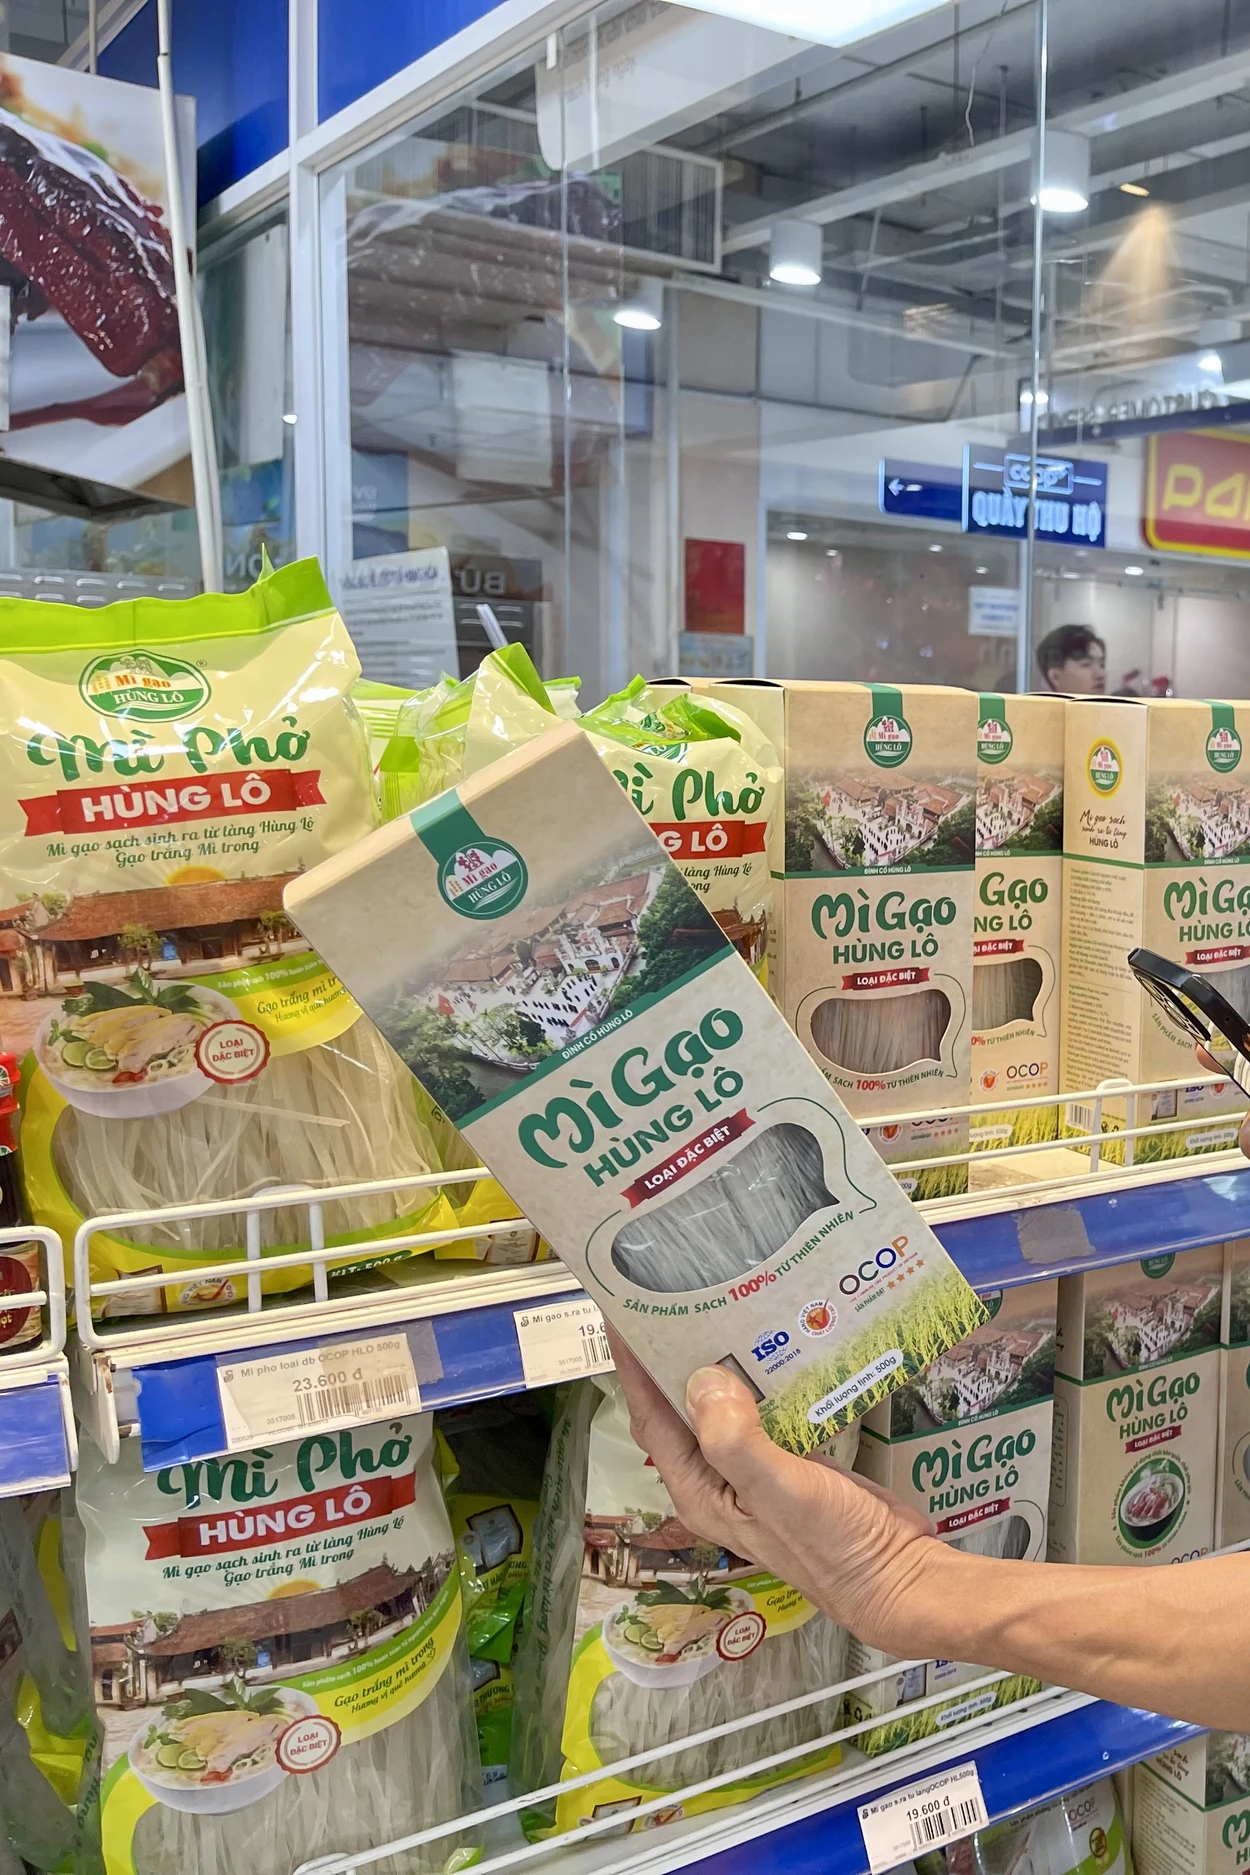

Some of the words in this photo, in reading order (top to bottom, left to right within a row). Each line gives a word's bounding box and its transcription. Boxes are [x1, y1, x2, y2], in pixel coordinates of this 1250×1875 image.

[1030, 499, 1069, 533] THU
[1072, 501, 1101, 542] HỘ
[113, 689, 159, 705] HÙNG
[161, 691, 184, 703] LÔ
[182, 716, 312, 774] Phở
[81, 785, 211, 823] HÙNG
[221, 773, 271, 807] LÔ
[46, 843, 67, 857] Mì
[72, 842, 100, 857] gạo
[105, 837, 140, 852] sạch
[145, 831, 176, 846] sinh
[182, 831, 199, 842] ra
[204, 827, 219, 840] từ
[223, 825, 256, 840] làng
[259, 820, 296, 836] Hùng
[300, 816, 315, 832] Lô
[115, 851, 147, 868] Gạo
[151, 844, 192, 861] trắng
[198, 844, 217, 856] Mì
[222, 840, 260, 854] trong
[691, 823, 728, 852] LÔ
[468, 881, 497, 903] HÙNG
[495, 870, 511, 886] LÔ
[684, 867, 711, 881] làng
[713, 865, 740, 877] Hùng
[742, 862, 753, 875] Lô
[979, 872, 1048, 910] Gạo
[875, 890, 957, 934] Gạo
[832, 938, 905, 965] HÙNG
[910, 932, 939, 958] LÔ
[1179, 920, 1233, 943] HÙNG
[220, 1039, 243, 1049] LOẠI
[562, 1041, 584, 1060] ĐÌNH
[583, 1030, 597, 1044] CỔ
[597, 1018, 622, 1036] HÙNG
[621, 1009, 633, 1021] LÔ
[212, 1051, 232, 1062] ĐẶC
[234, 1049, 255, 1059] BIỆT
[611, 1008, 744, 1107] Gạo
[1006, 1061, 1049, 1080] OCOP
[583, 1105, 693, 1187] HÙNG
[694, 1066, 744, 1113] LÔ
[644, 1163, 677, 1190] LOẠI
[676, 1144, 704, 1171] ĐẶC
[703, 1126, 730, 1150] BIỆT
[622, 1298, 649, 1315] SẢN
[651, 1302, 689, 1316] PHẨM
[694, 1296, 728, 1314] SẠCH
[728, 1270, 777, 1302] 100%
[774, 1259, 791, 1277] TỪ
[789, 1234, 821, 1265] THIÊN
[818, 1210, 854, 1238] NHIÊN
[838, 1235, 909, 1295] OCOP
[532, 1315, 543, 1323] Mi
[545, 1313, 562, 1323] gao
[564, 1309, 580, 1317] s.ra
[854, 1302, 864, 1313] SẢN
[863, 1294, 877, 1308] PHẨM
[875, 1287, 885, 1299] ĐẠT
[579, 1321, 606, 1337] 19.6
[751, 1331, 789, 1362] ISO
[240, 1367, 254, 1377] Mi
[257, 1363, 277, 1376] pho
[280, 1359, 299, 1370] loai
[302, 1357, 315, 1368] db
[318, 1350, 349, 1363] OCOP
[352, 1345, 374, 1357] HLO
[377, 1340, 401, 1352] 500g
[764, 1348, 802, 1375] 22000:2018
[293, 1370, 347, 1392] 23.600
[352, 1367, 363, 1381] đ
[814, 1399, 835, 1418] Khối
[834, 1384, 859, 1404] lượng
[857, 1370, 876, 1387] tịnh:
[875, 1355, 897, 1374] 500g
[1147, 1372, 1200, 1407] Gạo
[1119, 1413, 1166, 1440] HÙNG
[1169, 1402, 1188, 1424] LÔ
[297, 1422, 412, 1492] Phở
[966, 1429, 1036, 1473] Gạo
[929, 1479, 990, 1513] HÙNG
[995, 1465, 1019, 1492] LÔ
[200, 1505, 316, 1546] HÙNG
[325, 1485, 372, 1521] LÔ
[163, 1567, 181, 1579] Mì
[185, 1563, 211, 1578] gạo
[215, 1556, 248, 1573] sạch
[252, 1550, 281, 1565] sinh
[286, 1547, 301, 1558] ra
[306, 1541, 321, 1554] từ
[323, 1534, 353, 1551] làng
[357, 1523, 389, 1541] Hùng
[393, 1515, 405, 1529] Lô
[224, 1571, 253, 1587] Gạo
[256, 1562, 294, 1579] trắng
[300, 1557, 317, 1570] Mì
[321, 1549, 354, 1565] trong
[734, 1626, 751, 1636] LOẠI
[334, 1693, 359, 1708] Gạo
[362, 1675, 393, 1696] trắng
[396, 1661, 410, 1679] mì
[411, 1637, 434, 1666] trong
[351, 1696, 379, 1713] Hương
[380, 1690, 388, 1700] vị
[290, 1745, 307, 1756] ĐẶC
[309, 1739, 327, 1751] BIỆT
[297, 1732, 318, 1743] LOẠI
[881, 1802, 893, 1811] gao
[906, 1800, 940, 1821] 19.600
[943, 1795, 950, 1807] đ
